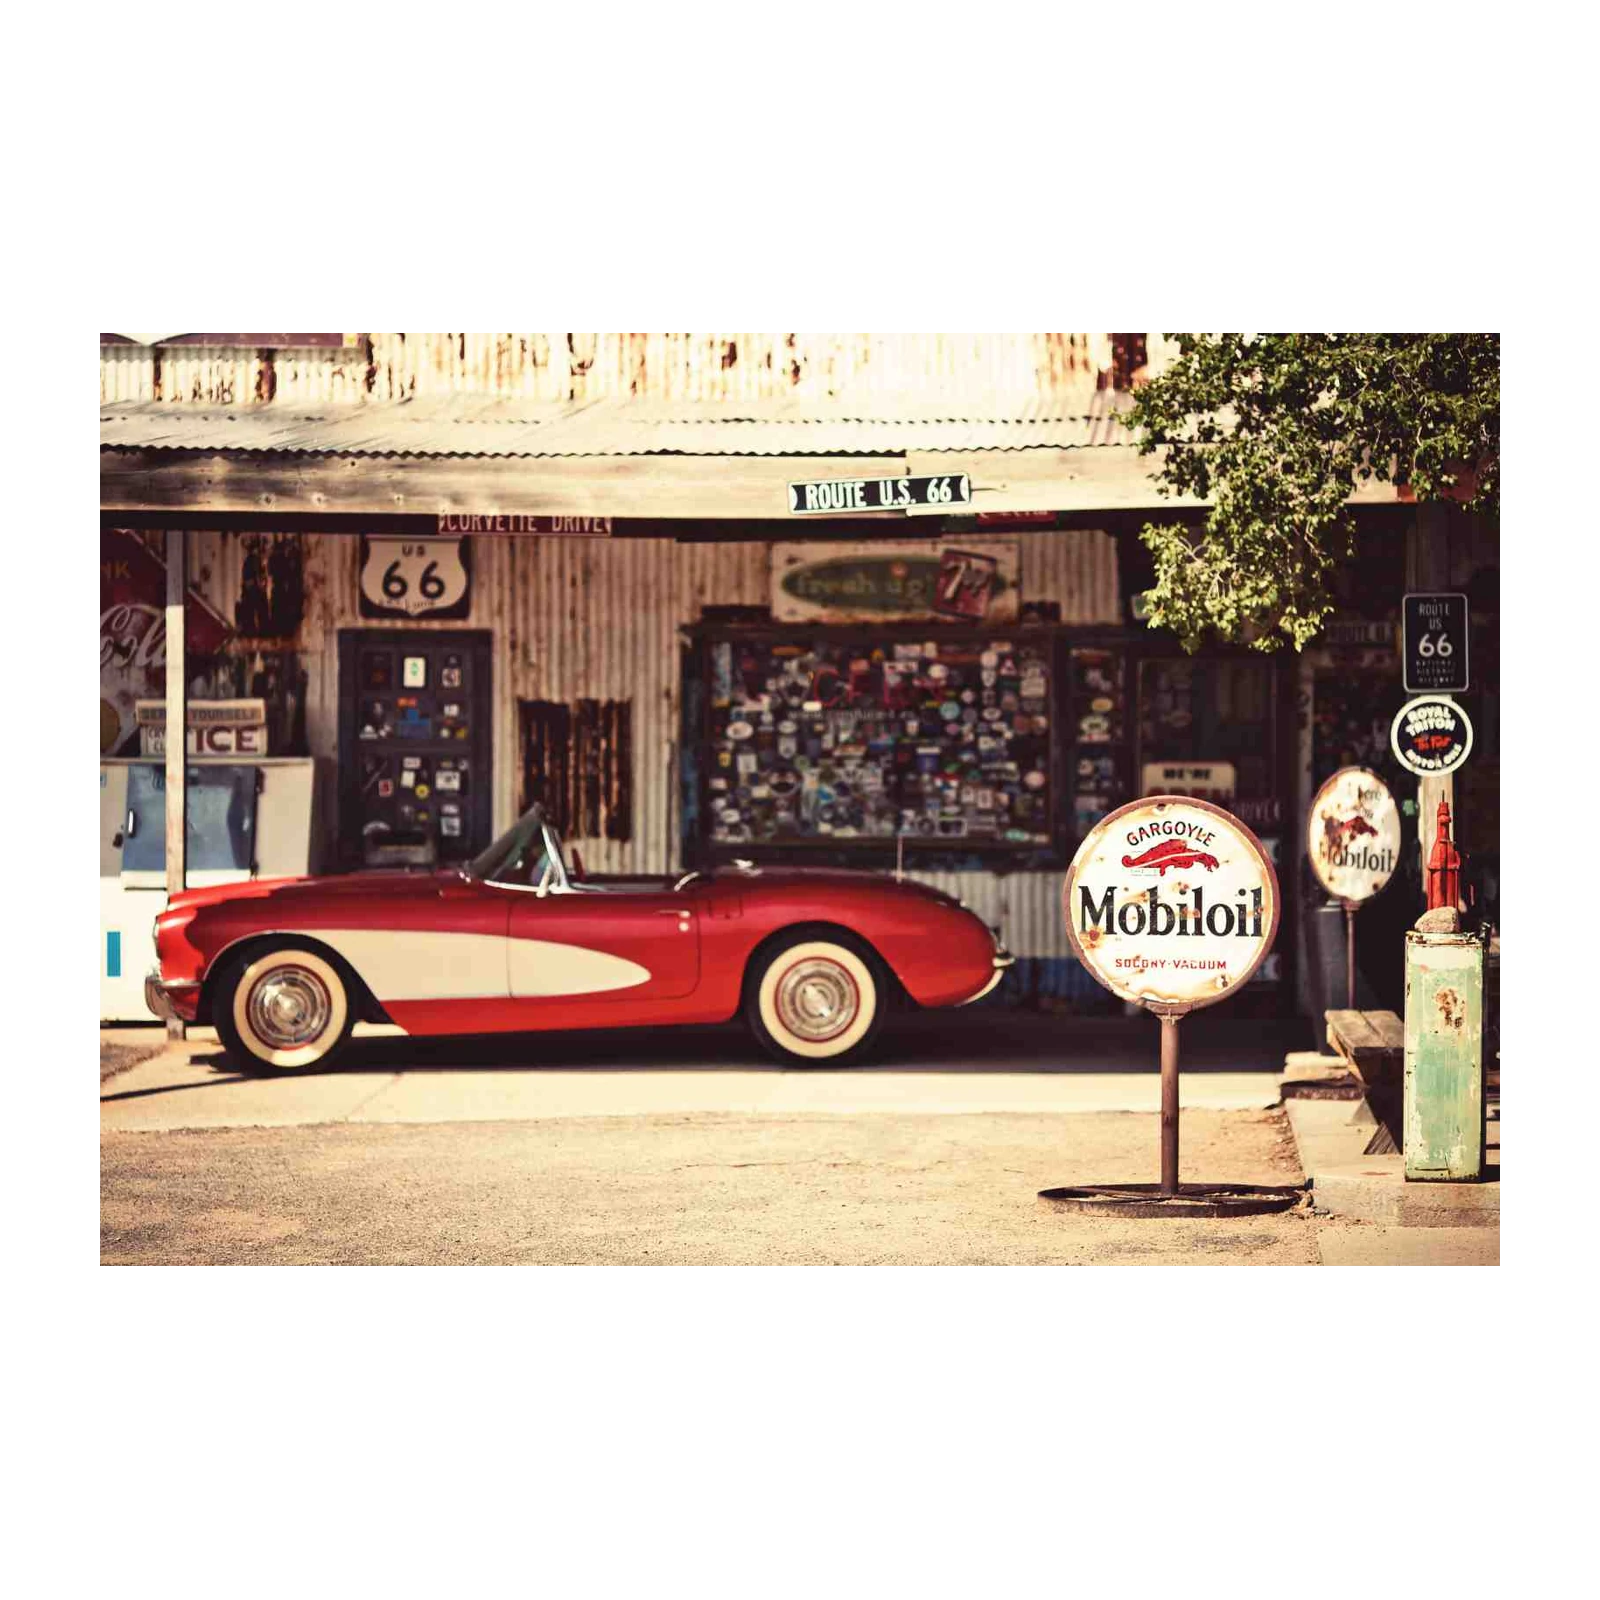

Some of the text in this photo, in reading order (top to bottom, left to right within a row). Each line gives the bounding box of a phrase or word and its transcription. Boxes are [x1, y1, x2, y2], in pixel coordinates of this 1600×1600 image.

[805, 478, 952, 510] ROUTE U.S. 66
[447, 514, 603, 532] CORVETTE DRIVE
[402, 544, 426, 557] US
[382, 560, 445, 599] 66
[1419, 603, 1450, 616] ROUTE
[1429, 617, 1442, 630] US
[1419, 633, 1453, 657] 66
[1407, 706, 1451, 723] ROYAL
[195, 725, 258, 753] ICE
[1405, 718, 1456, 737] TRITON
[1126, 820, 1216, 847] GARGOYLE
[1321, 844, 1393, 873] obiloil
[1078, 885, 1264, 937] Mobiloil
